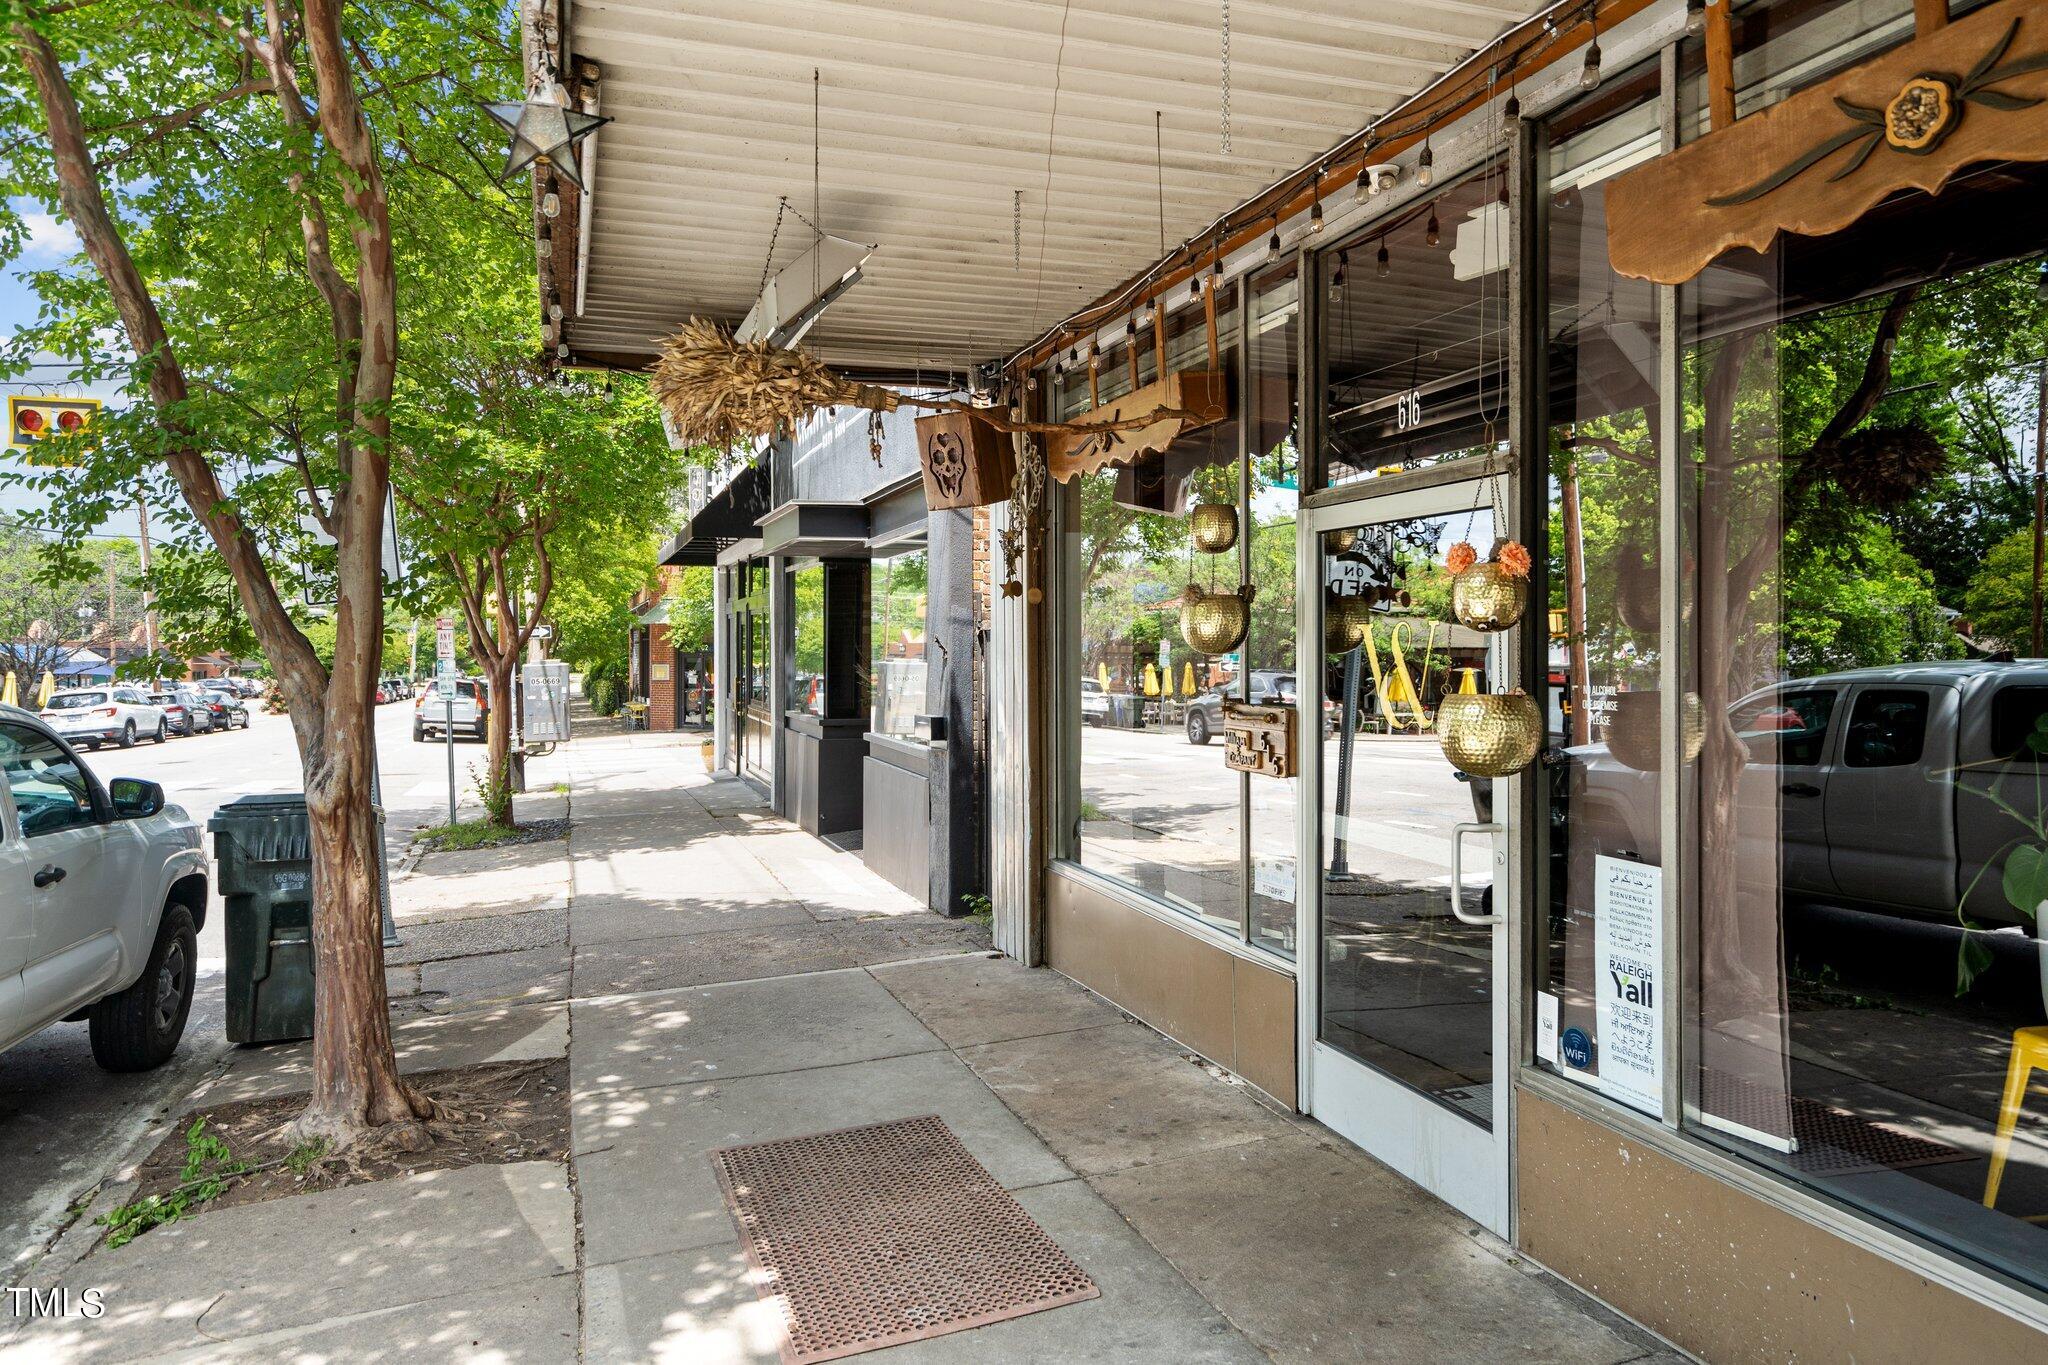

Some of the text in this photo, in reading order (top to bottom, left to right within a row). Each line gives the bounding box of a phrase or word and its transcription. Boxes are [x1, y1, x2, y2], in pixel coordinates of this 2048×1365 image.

[1398, 391, 1420, 429] 616
[1591, 685, 1617, 696] ALCOHOL
[1609, 890, 1646, 905] BIENVENUE
[1610, 907, 1645, 920] WILLKOMMEN
[1609, 953, 1652, 971] WELCOME TO
[1609, 959, 1653, 982] RALEIGH
[1610, 1002, 1654, 1028] 欢迎来到
[1611, 1032, 1653, 1054] へようこそ
[1565, 1046, 1587, 1063] WiFi
